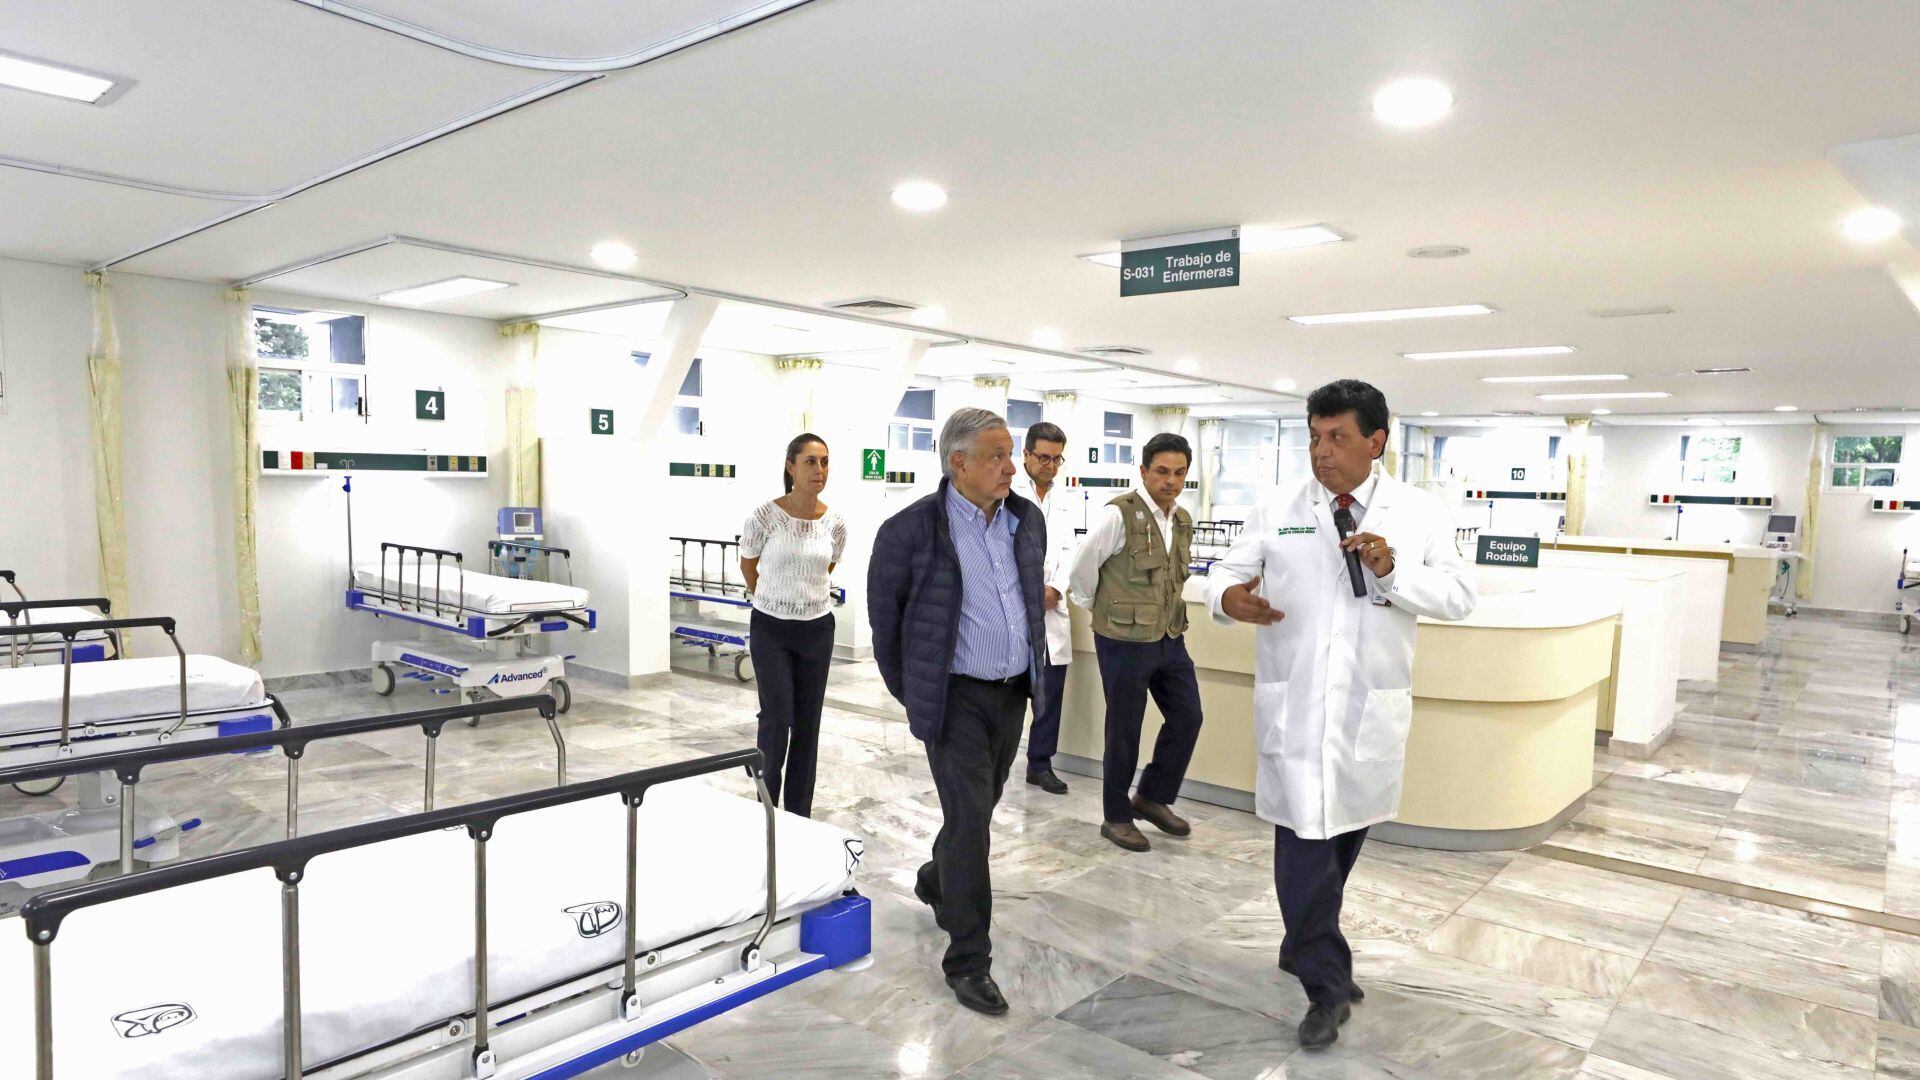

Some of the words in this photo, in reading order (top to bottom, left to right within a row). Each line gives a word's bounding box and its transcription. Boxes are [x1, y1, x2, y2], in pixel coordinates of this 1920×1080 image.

[1166, 252, 1211, 268] Trabajo
[1215, 250, 1232, 263] de
[1123, 265, 1154, 280] S-031
[1163, 266, 1234, 283] Enfermeras
[425, 396, 438, 415] 4
[598, 414, 609, 430] 5
[1091, 450, 1097, 461] 8
[1512, 469, 1524, 479] 10
[1490, 540, 1527, 552] Equipo
[1485, 551, 1529, 562] Rodable
